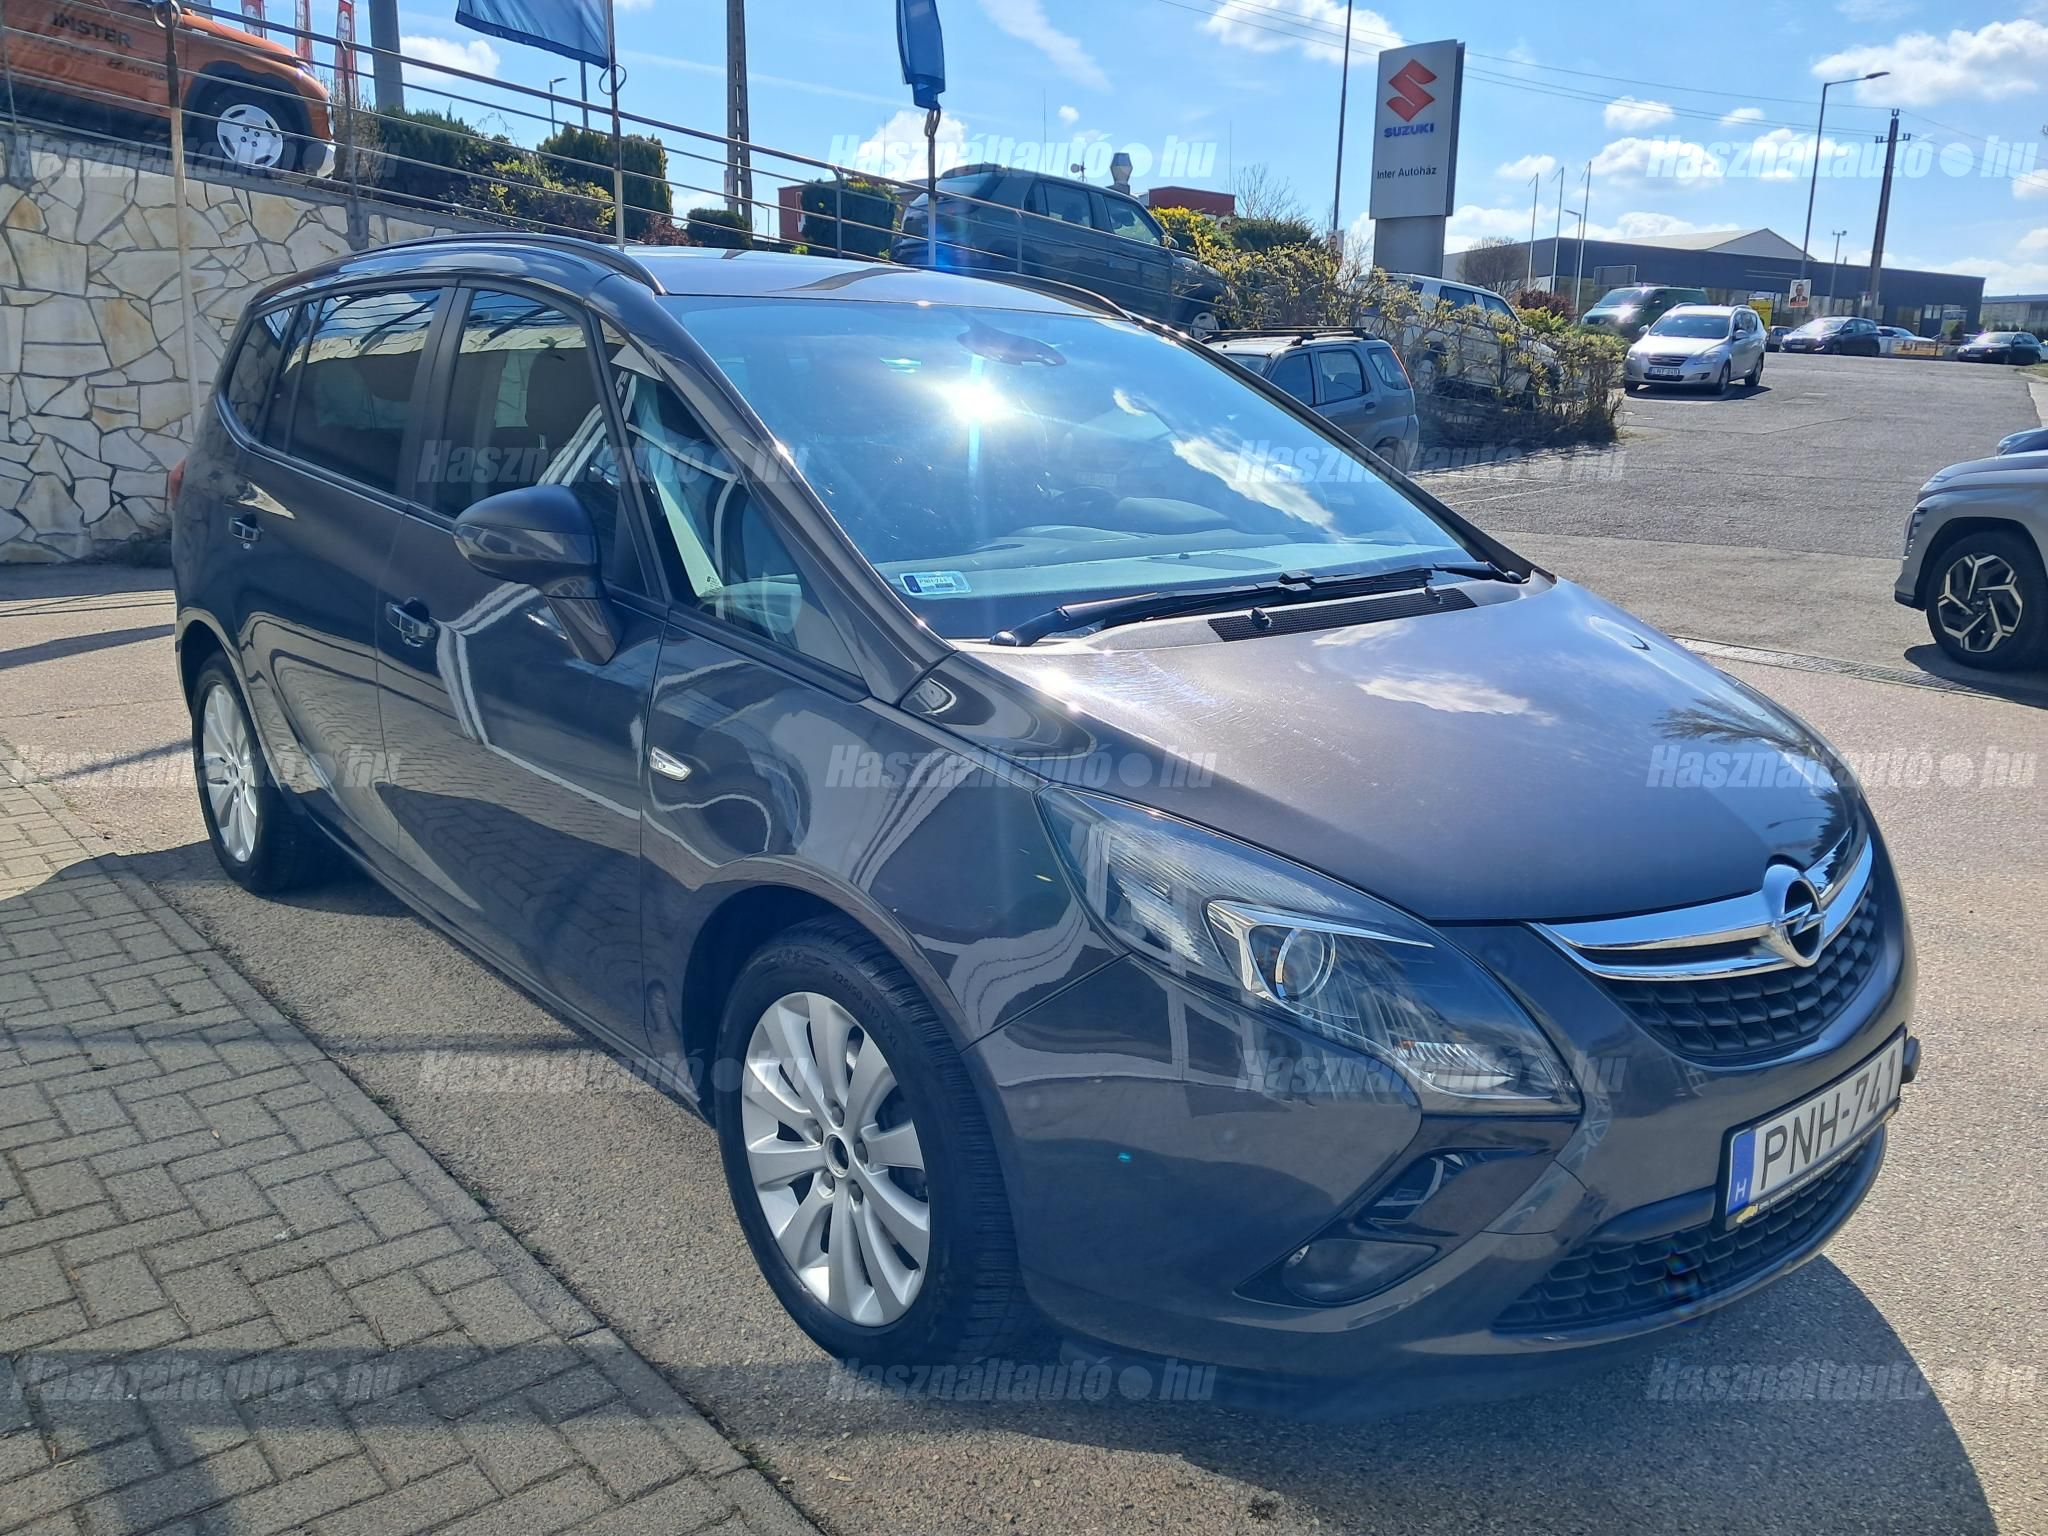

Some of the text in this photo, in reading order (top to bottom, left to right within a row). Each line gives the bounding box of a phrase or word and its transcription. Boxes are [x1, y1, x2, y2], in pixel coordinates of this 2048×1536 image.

[53, 12, 133, 48] INSTER
[127, 64, 167, 81] HYUND
[1384, 123, 1434, 138] SUZUKI
[1377, 165, 1437, 180] Inter Autóház
[831, 970, 863, 1000] 225/50
[1760, 1048, 1897, 1190] PNH-741
[1735, 1177, 1748, 1202] H
